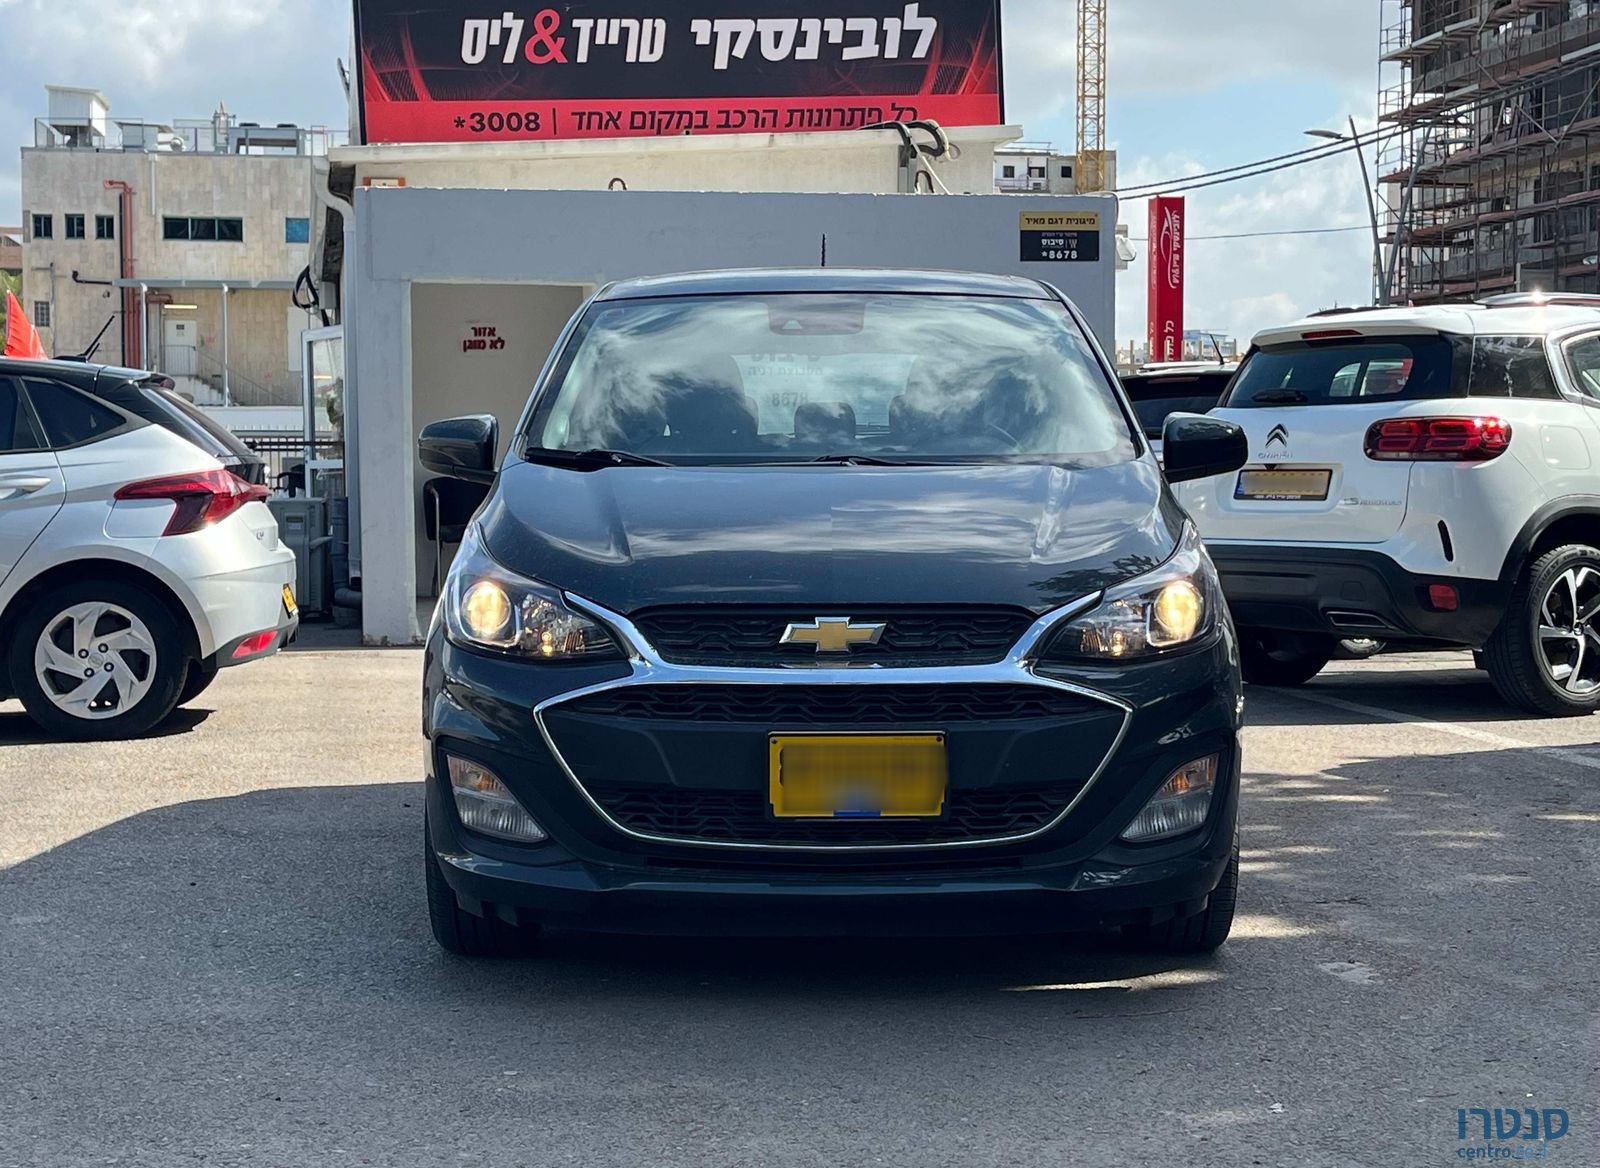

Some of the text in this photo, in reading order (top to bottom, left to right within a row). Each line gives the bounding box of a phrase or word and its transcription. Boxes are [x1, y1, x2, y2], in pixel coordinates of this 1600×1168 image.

[461, 2, 937, 70] לובינסקי טרייד&ליס
[571, 110, 622, 131] אחד
[629, 109, 709, 135] במקום
[716, 108, 778, 129] הרכב
[784, 107, 882, 128] פתרונות
[890, 102, 918, 122] כל
[1025, 217, 1095, 225] מיגונית דגם מאיר
[1041, 238, 1065, 246] סיבוס
[471, 326, 496, 336] אזור
[489, 336, 505, 349] לא
